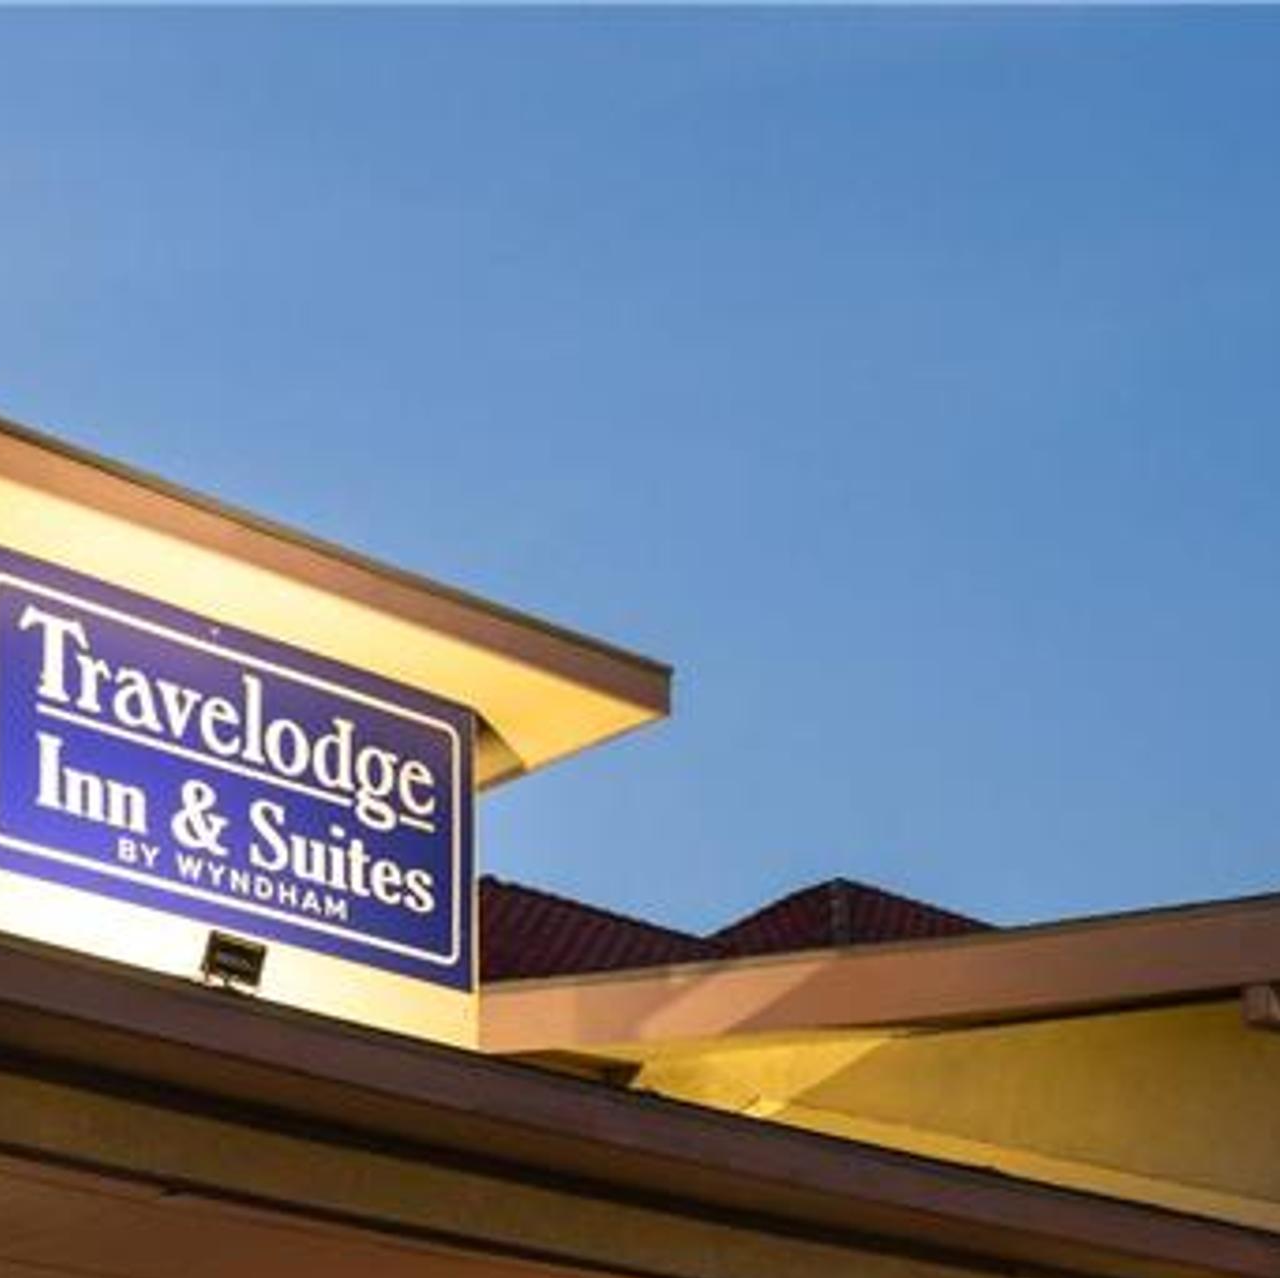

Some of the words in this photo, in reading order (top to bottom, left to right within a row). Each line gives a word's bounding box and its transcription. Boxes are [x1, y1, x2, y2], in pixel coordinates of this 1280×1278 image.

[20, 604, 436, 831] Travelodge
[36, 731, 147, 833] Inn
[171, 779, 229, 856] &
[249, 799, 435, 914] Suites
[118, 838, 160, 868] BY
[176, 854, 349, 921] WYNDHAM
